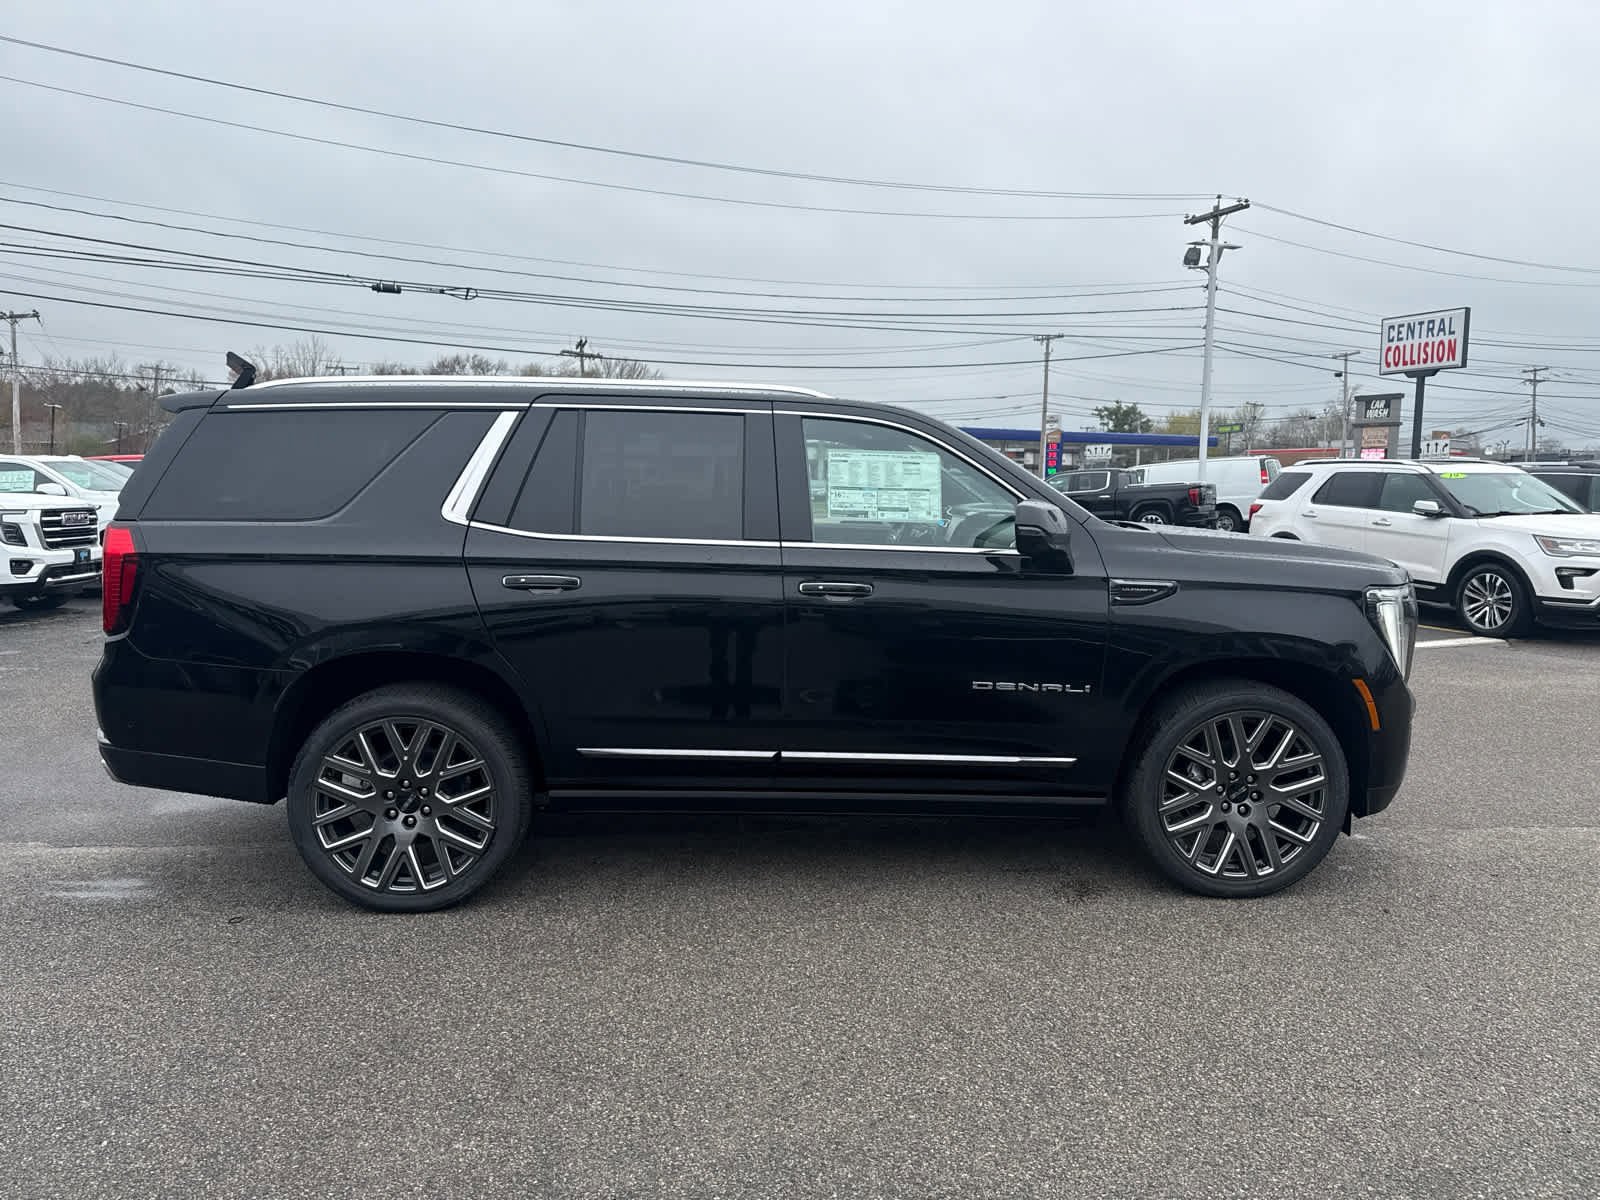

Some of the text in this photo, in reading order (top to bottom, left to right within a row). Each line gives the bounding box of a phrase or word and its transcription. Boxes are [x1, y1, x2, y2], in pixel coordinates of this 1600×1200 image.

[1387, 316, 1456, 344] CENTRAL
[1384, 338, 1457, 369] COLLISION
[1370, 399, 1386, 409] CAR
[1366, 407, 1389, 418] WASH
[971, 680, 1092, 694] DENALI
